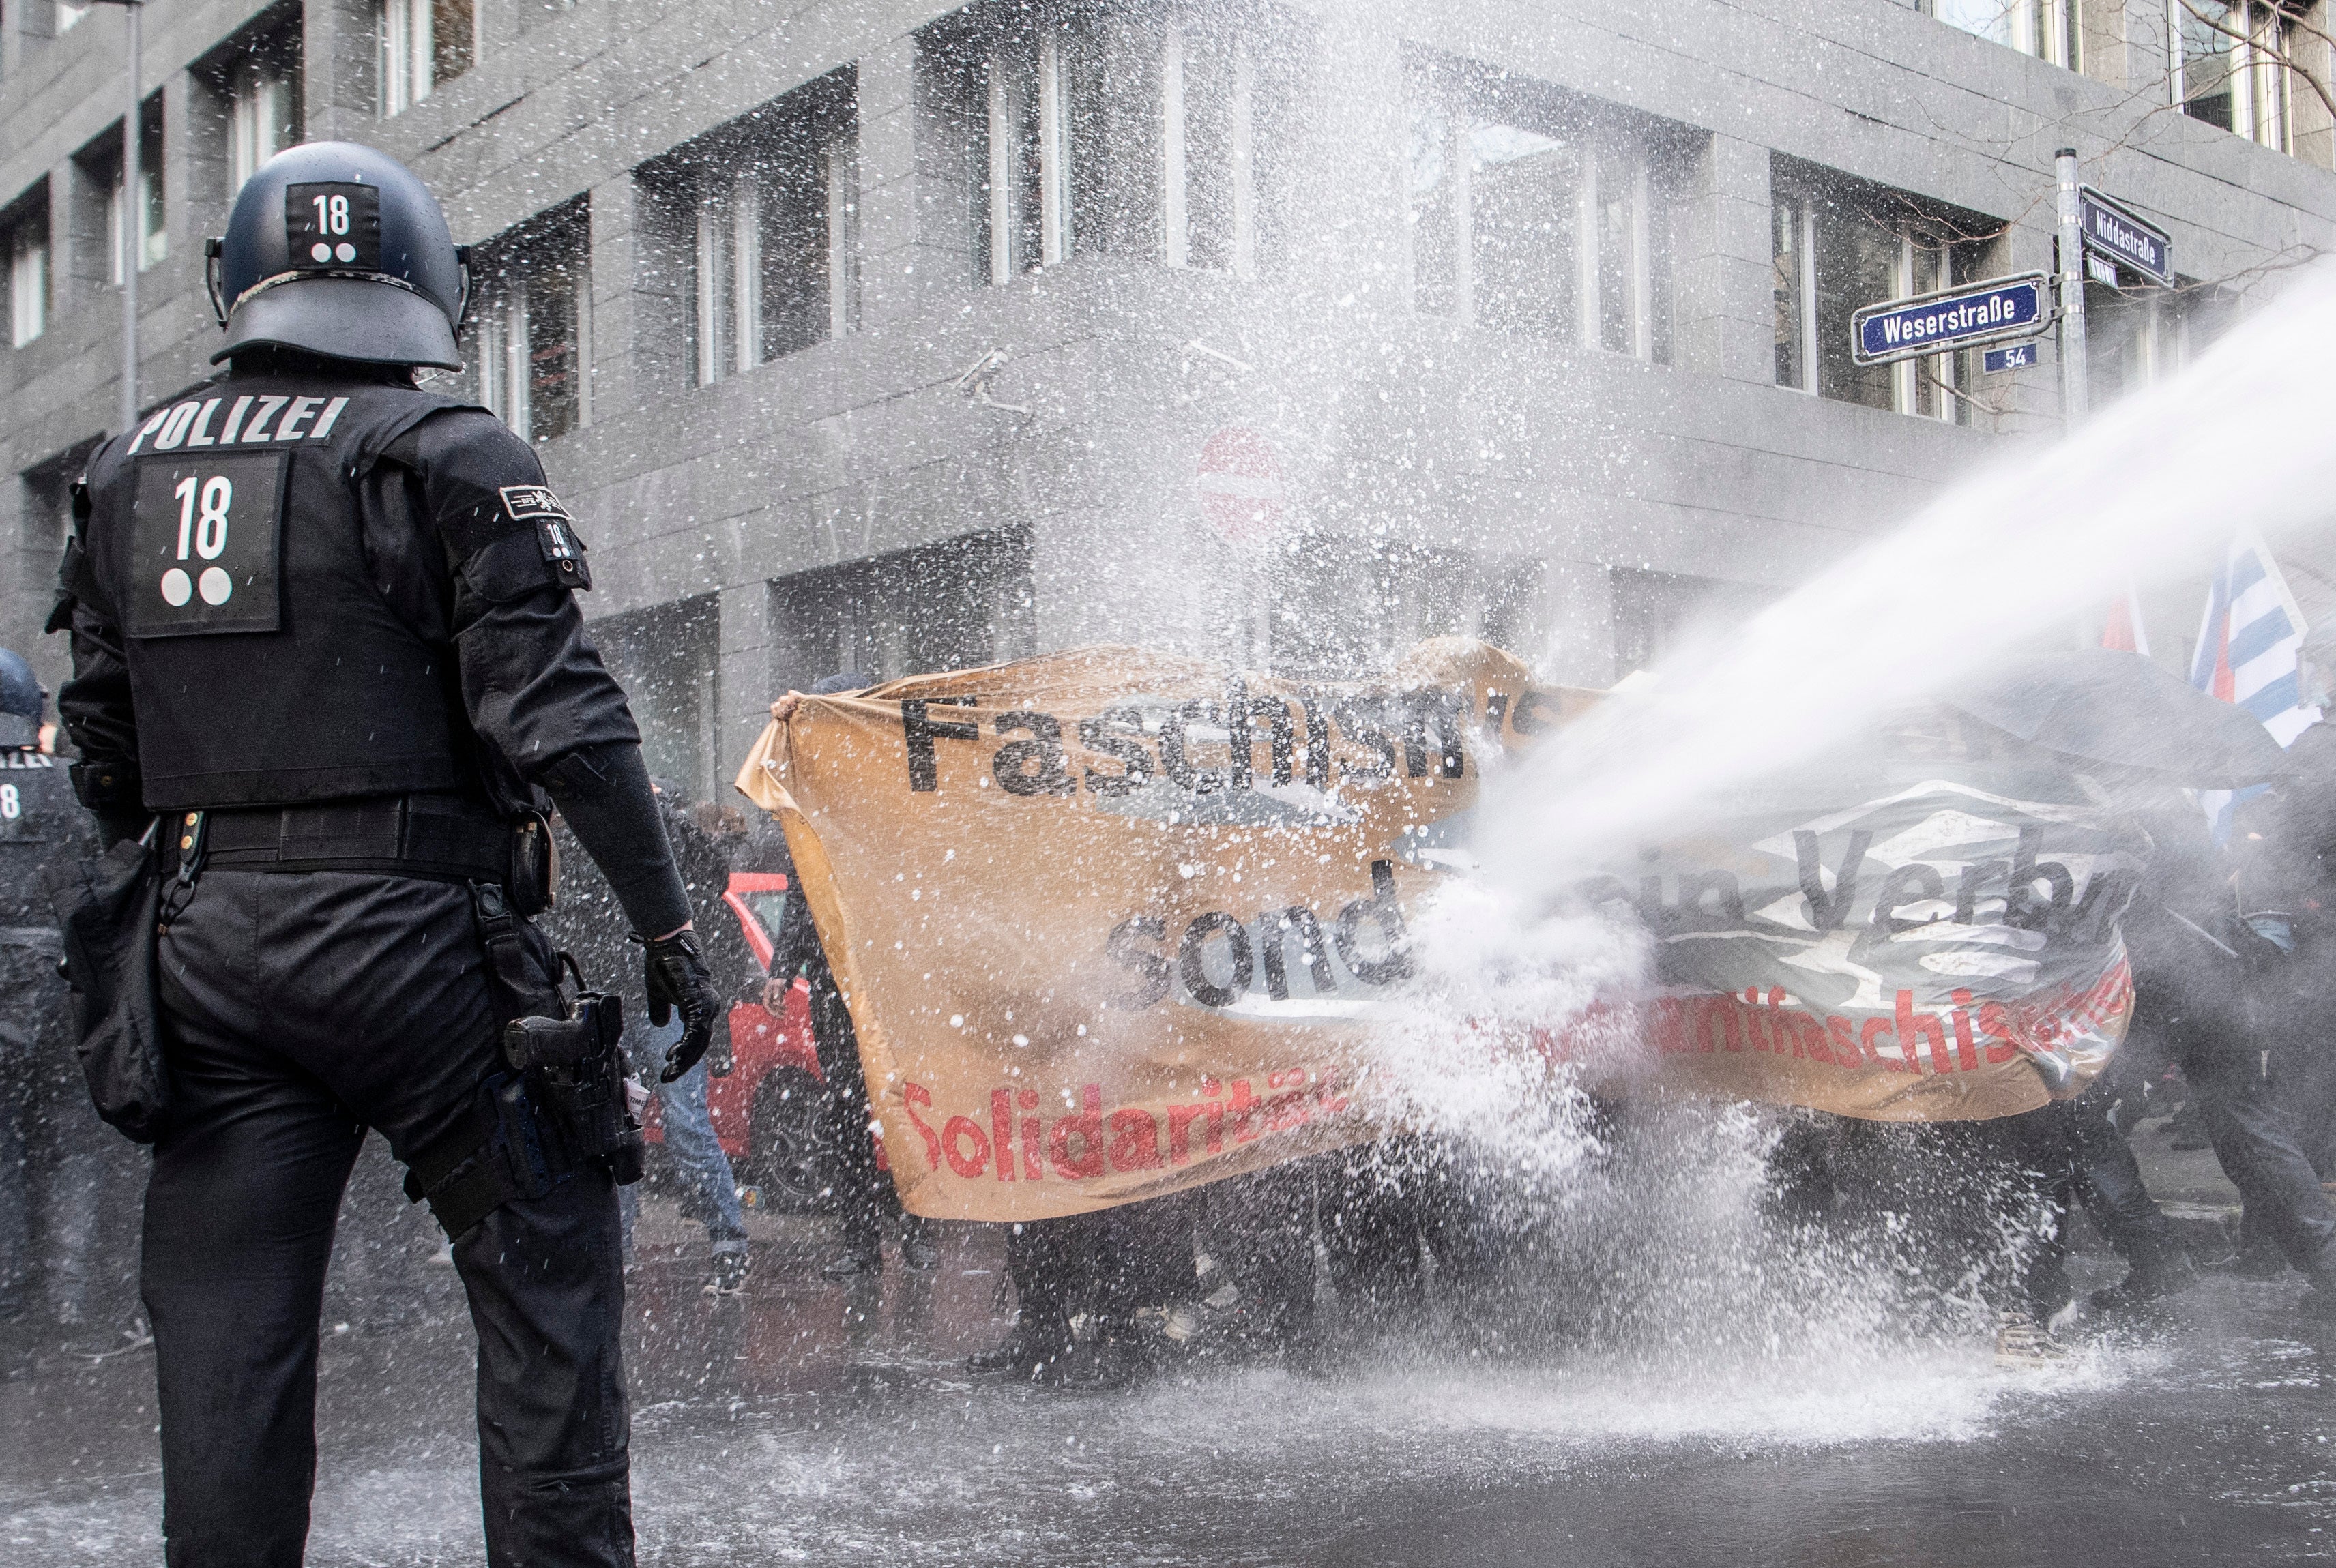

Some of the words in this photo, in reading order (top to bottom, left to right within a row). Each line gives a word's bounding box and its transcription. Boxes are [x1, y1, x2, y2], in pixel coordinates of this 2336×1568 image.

[312, 194, 350, 235] 18
[2096, 209, 2156, 265] Niddastraße
[1883, 295, 2015, 344] Weserstraße
[2004, 347, 2027, 369] 54
[127, 395, 351, 456] POLIZEI
[174, 475, 233, 561] 18
[546, 524, 565, 545] 18
[0, 783, 21, 819] 8
[1105, 859, 1416, 1012] sond
